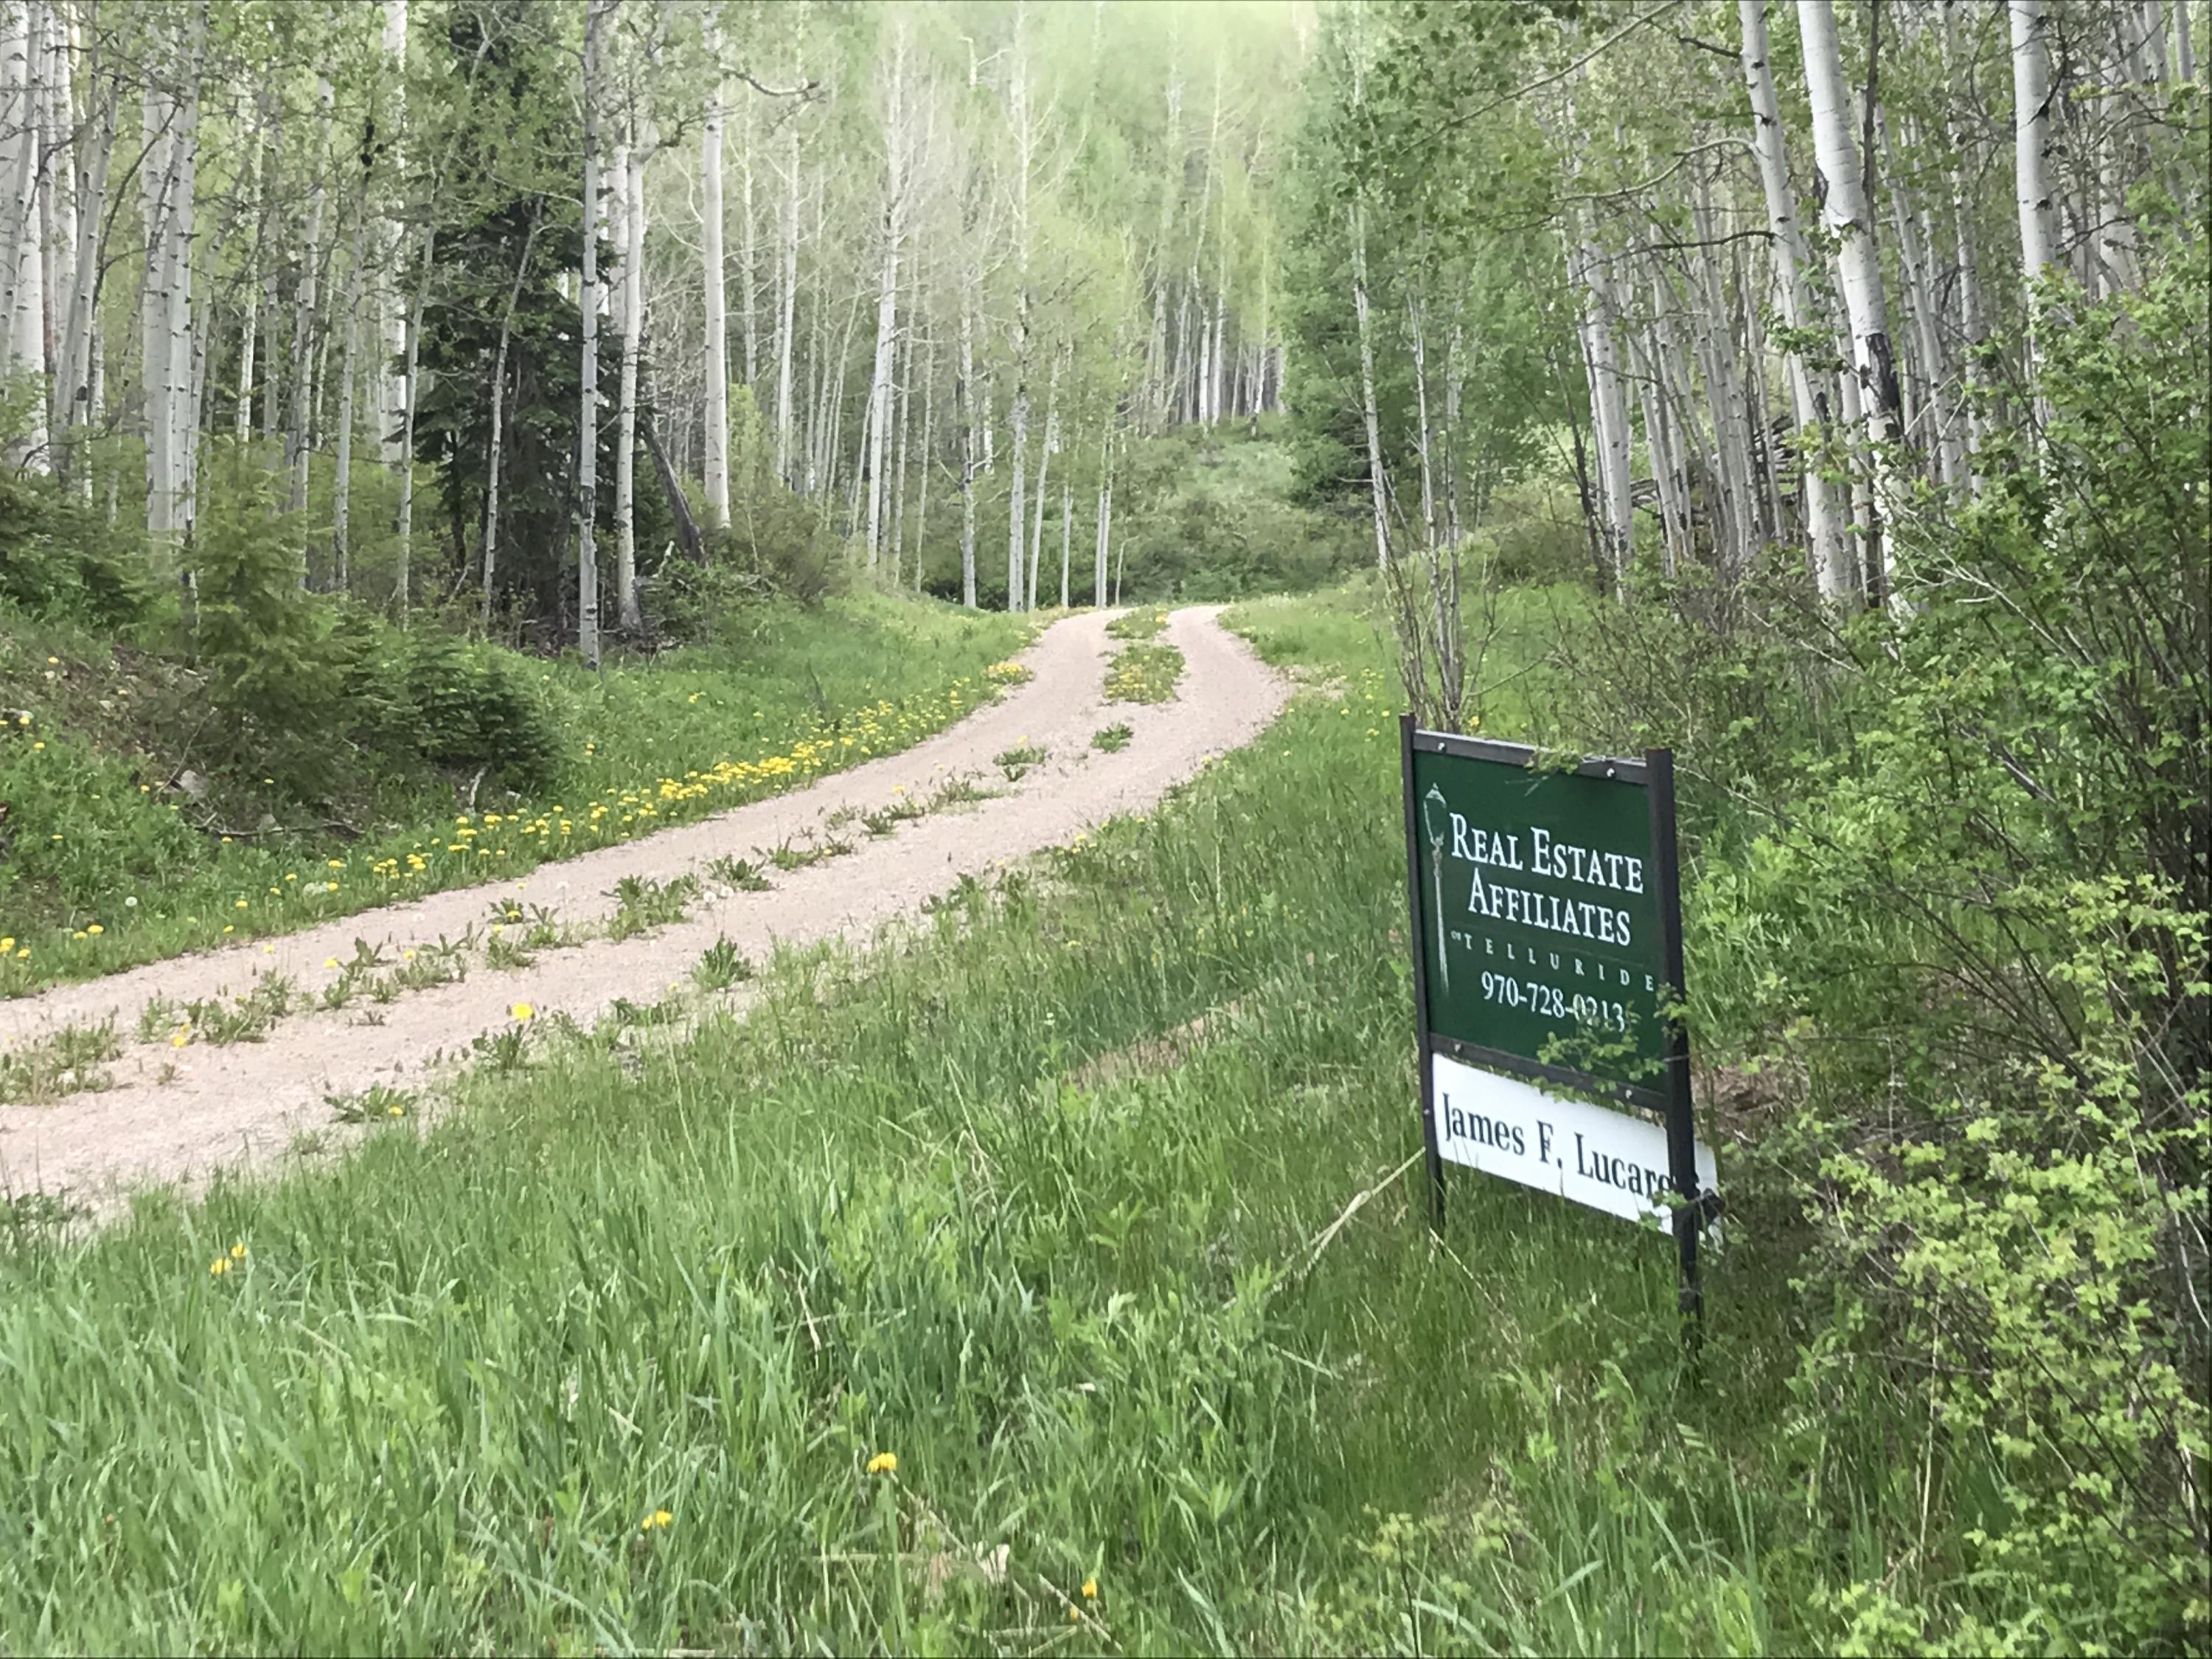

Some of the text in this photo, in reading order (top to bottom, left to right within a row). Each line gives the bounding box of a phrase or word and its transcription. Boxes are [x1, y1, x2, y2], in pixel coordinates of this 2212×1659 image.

[1450, 812, 1644, 894] REAL ESTATE
[1467, 867, 1631, 946] AFFILIATES
[1464, 933, 1655, 992] TELLURIDE
[1442, 1092, 1525, 1155] James
